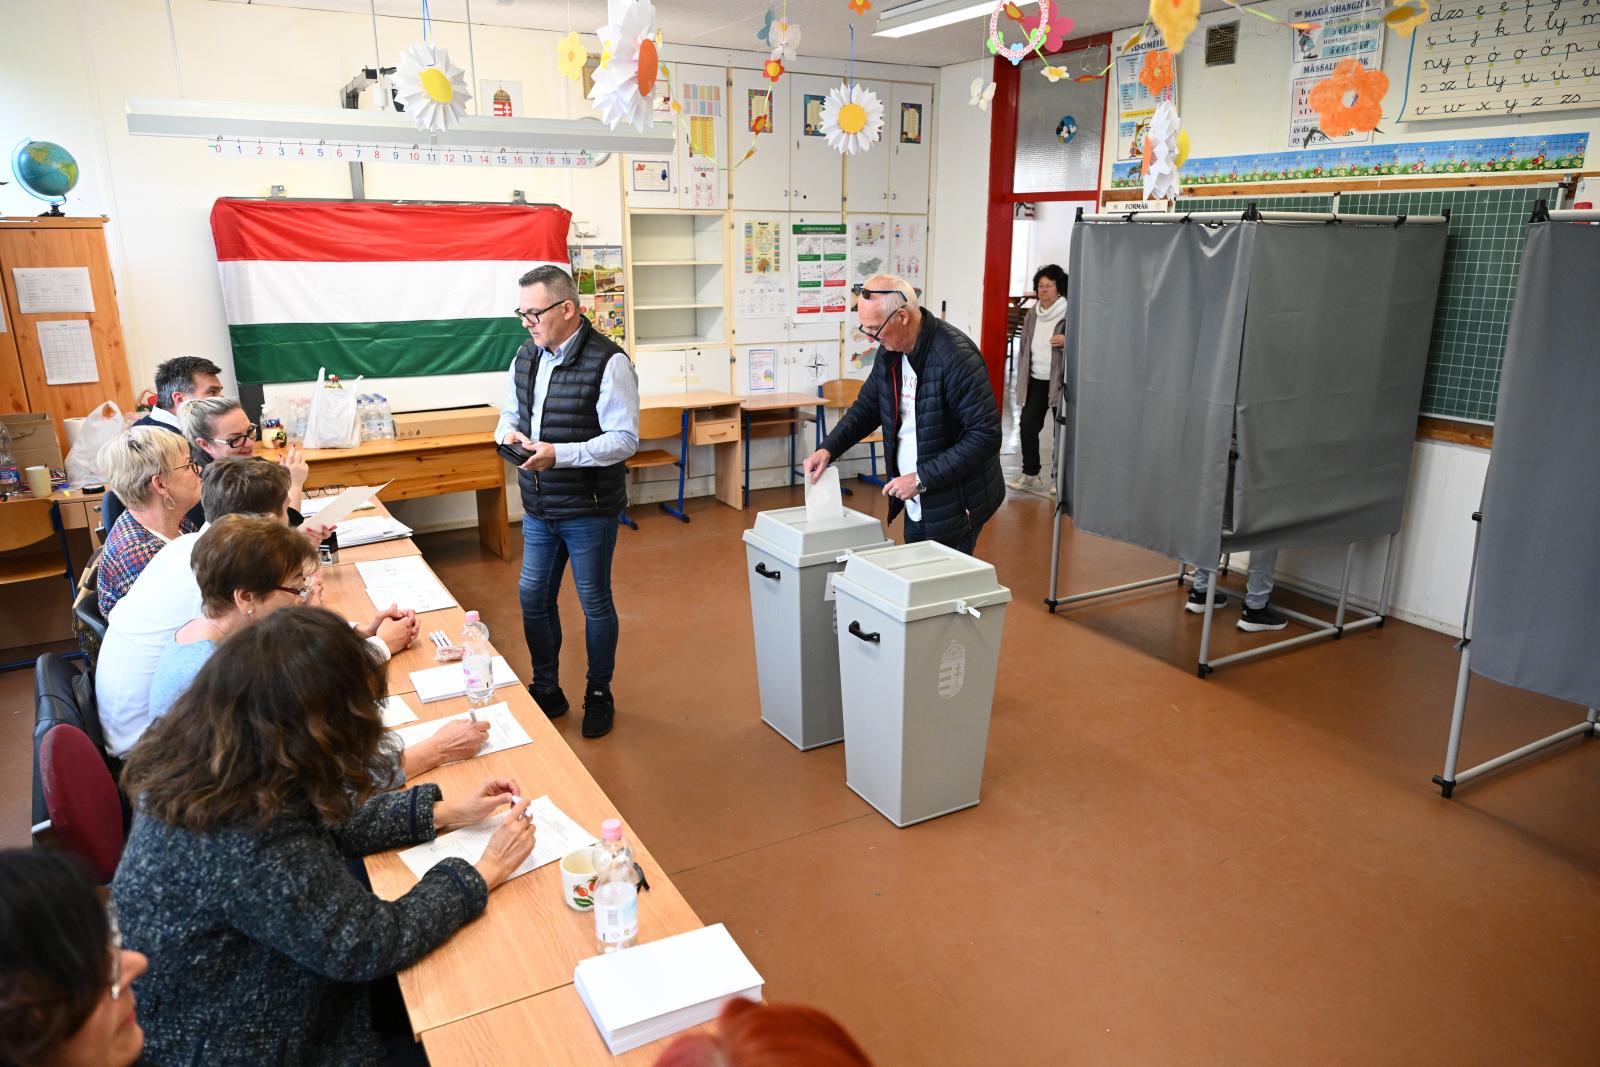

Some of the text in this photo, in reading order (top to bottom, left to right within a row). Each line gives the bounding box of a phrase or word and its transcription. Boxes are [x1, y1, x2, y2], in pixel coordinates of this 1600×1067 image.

[1495, 18, 1511, 38] k
[1545, 11, 1568, 36] ly
[1424, 57, 1452, 75] ny
[1464, 54, 1478, 66] o
[1488, 45, 1502, 63] ó
[1521, 72, 1540, 83] u
[1550, 62, 1571, 80] ú
[1476, 101, 1492, 112] x
[1504, 98, 1519, 114] y
[1531, 96, 1544, 107] z
[1560, 93, 1581, 105] zs
[215, 144, 588, 166] 0 1 2 3 4 5 6 7 8 9 10 11 12 13 14 15 16 17 18 19 20
